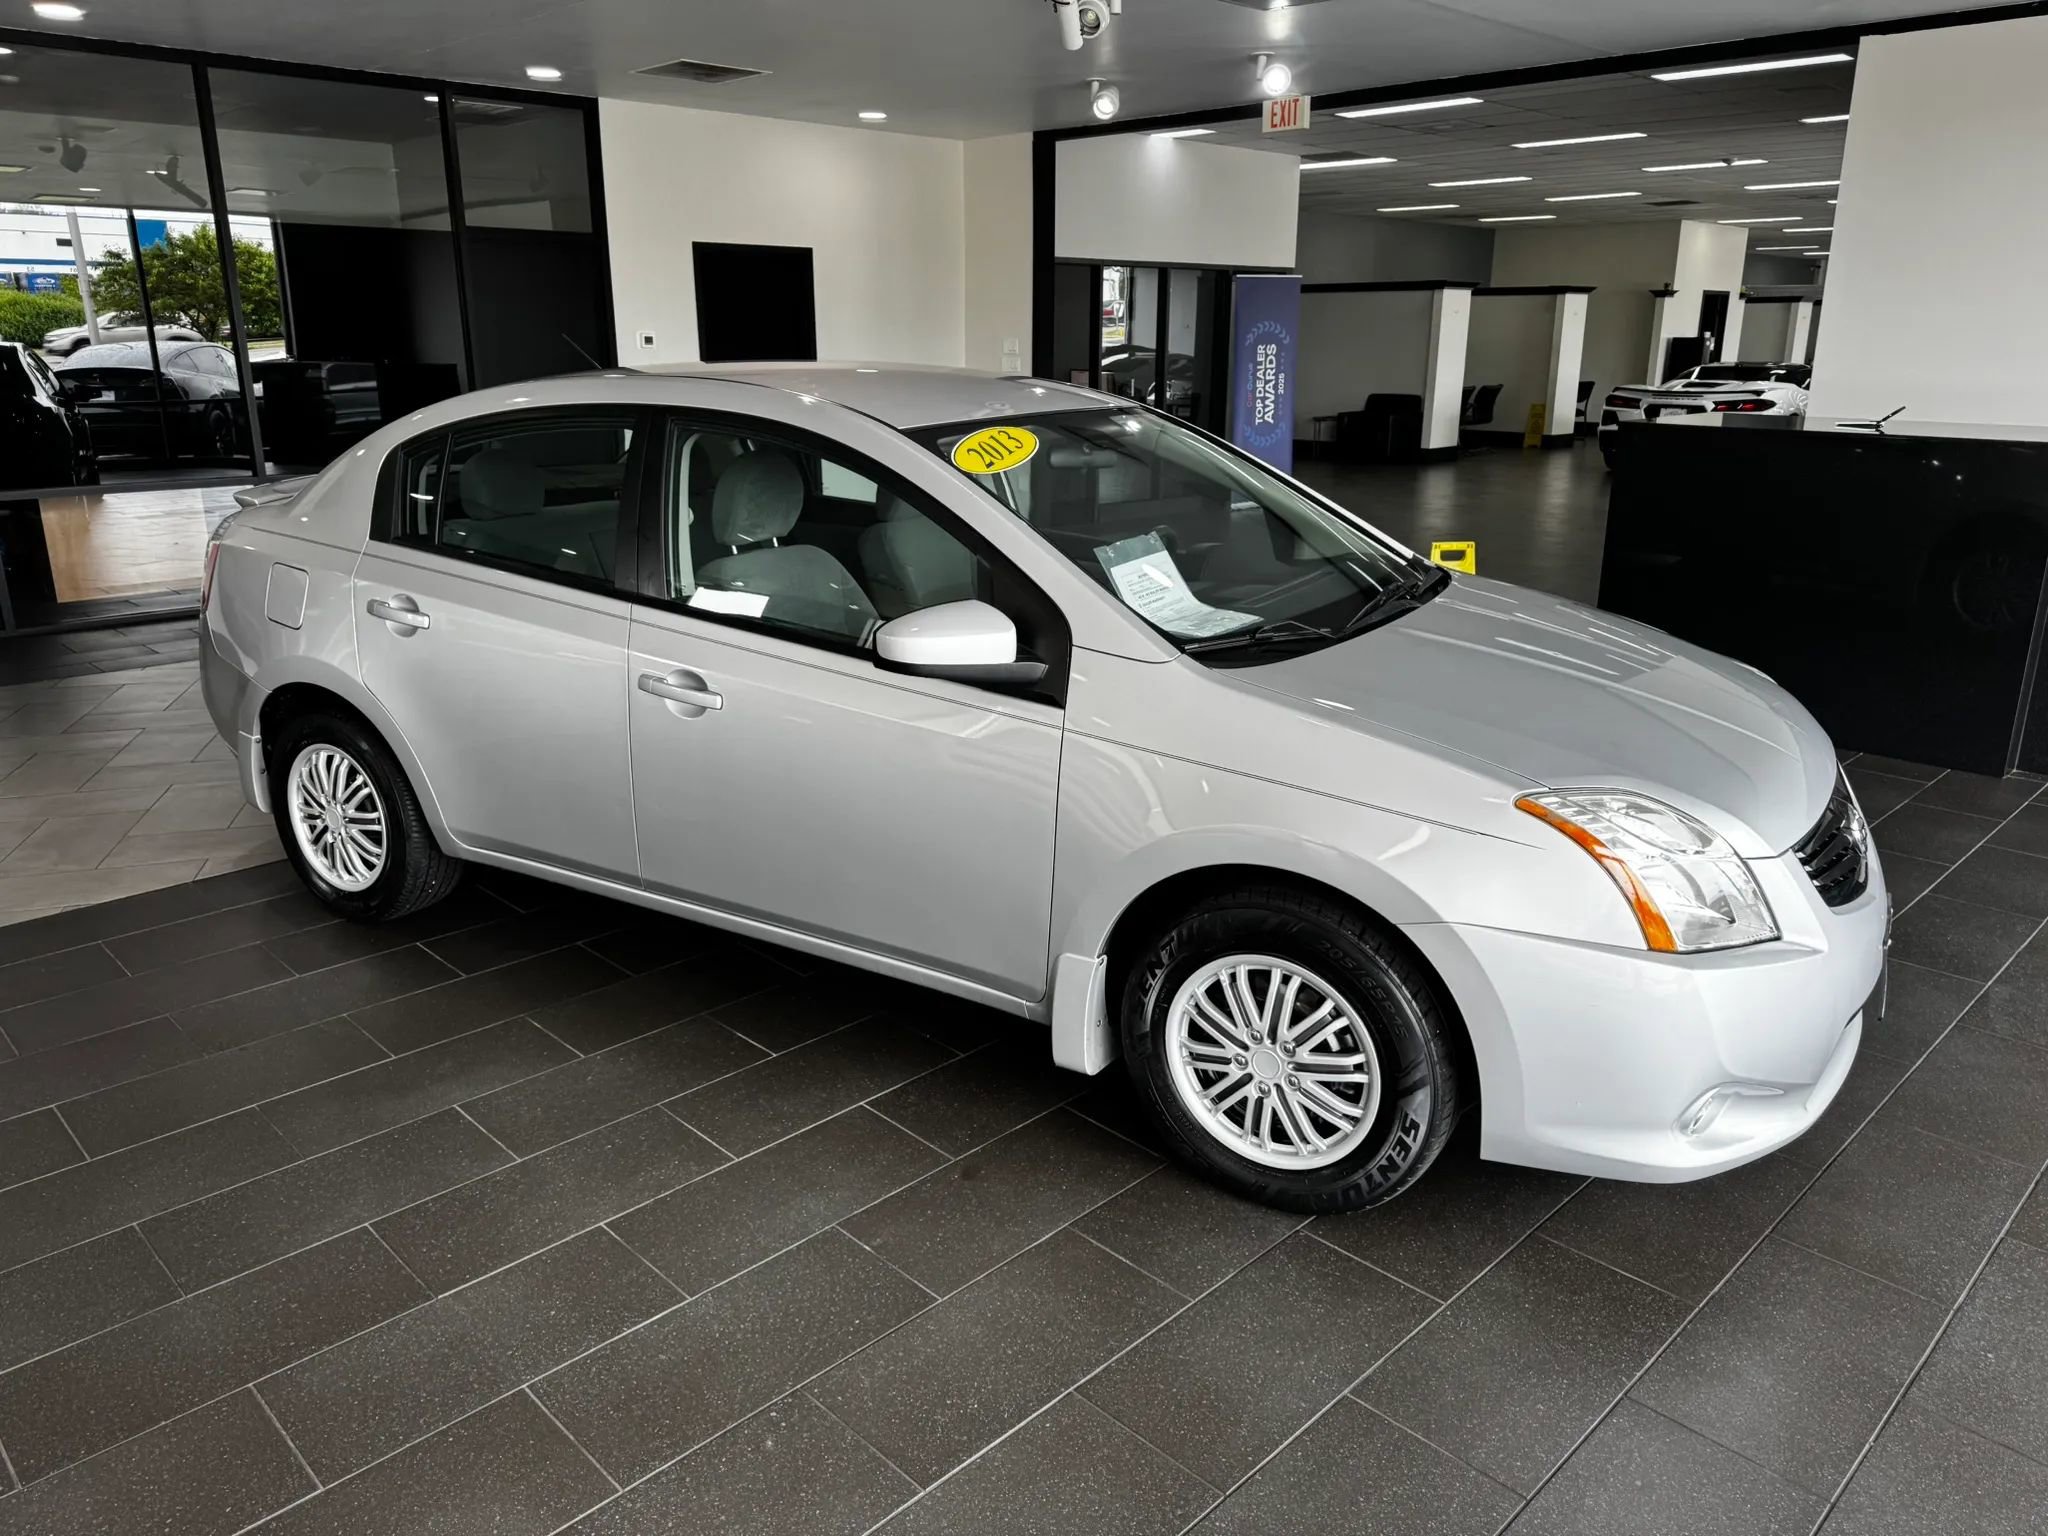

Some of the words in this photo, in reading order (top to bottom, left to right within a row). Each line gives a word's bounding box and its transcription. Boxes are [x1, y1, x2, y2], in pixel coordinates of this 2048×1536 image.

[1271, 98, 1300, 128] EXIT
[1256, 344, 1266, 397] DEALER
[1264, 343, 1277, 424] AWARDS
[1255, 399, 1264, 425] TOP
[967, 430, 1023, 469] 2013
